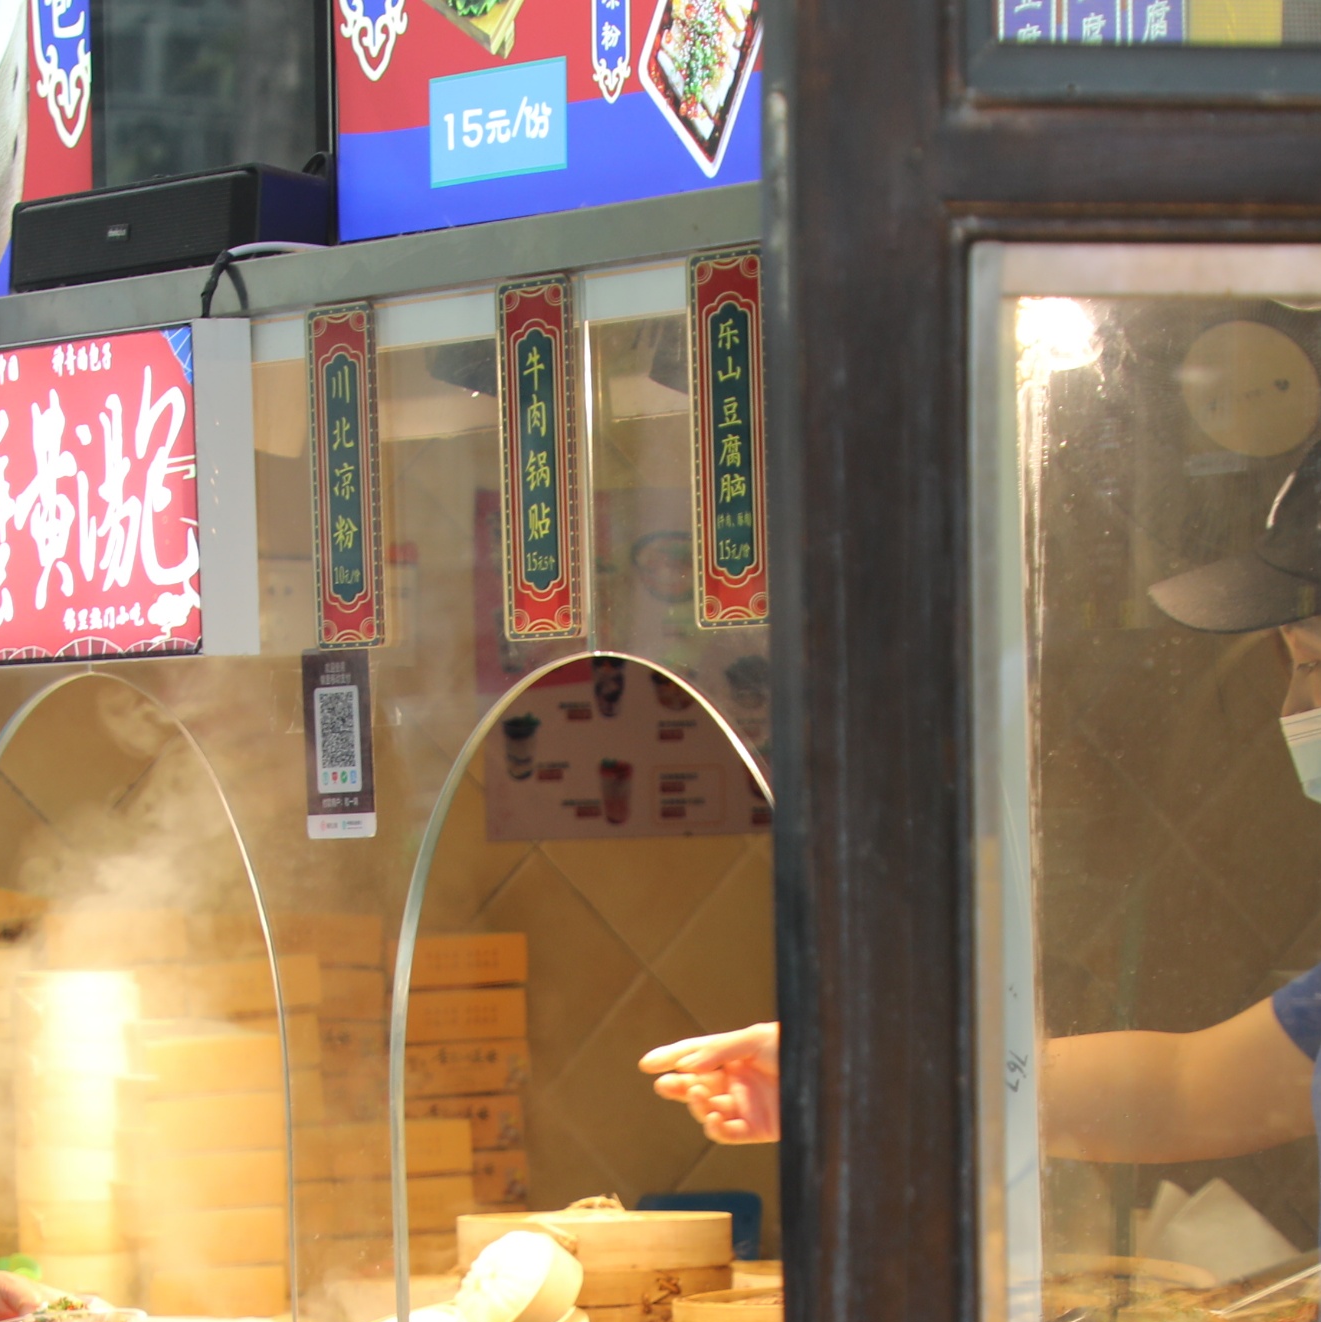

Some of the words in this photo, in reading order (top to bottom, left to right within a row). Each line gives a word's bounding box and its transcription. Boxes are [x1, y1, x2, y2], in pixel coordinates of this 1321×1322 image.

[443, 96, 553, 151] 15元/份
[331, 365, 359, 553] 川北凉粉
[523, 346, 552, 542] 牛肉锅贴
[717, 318, 747, 504] 乐山豆腐脑
